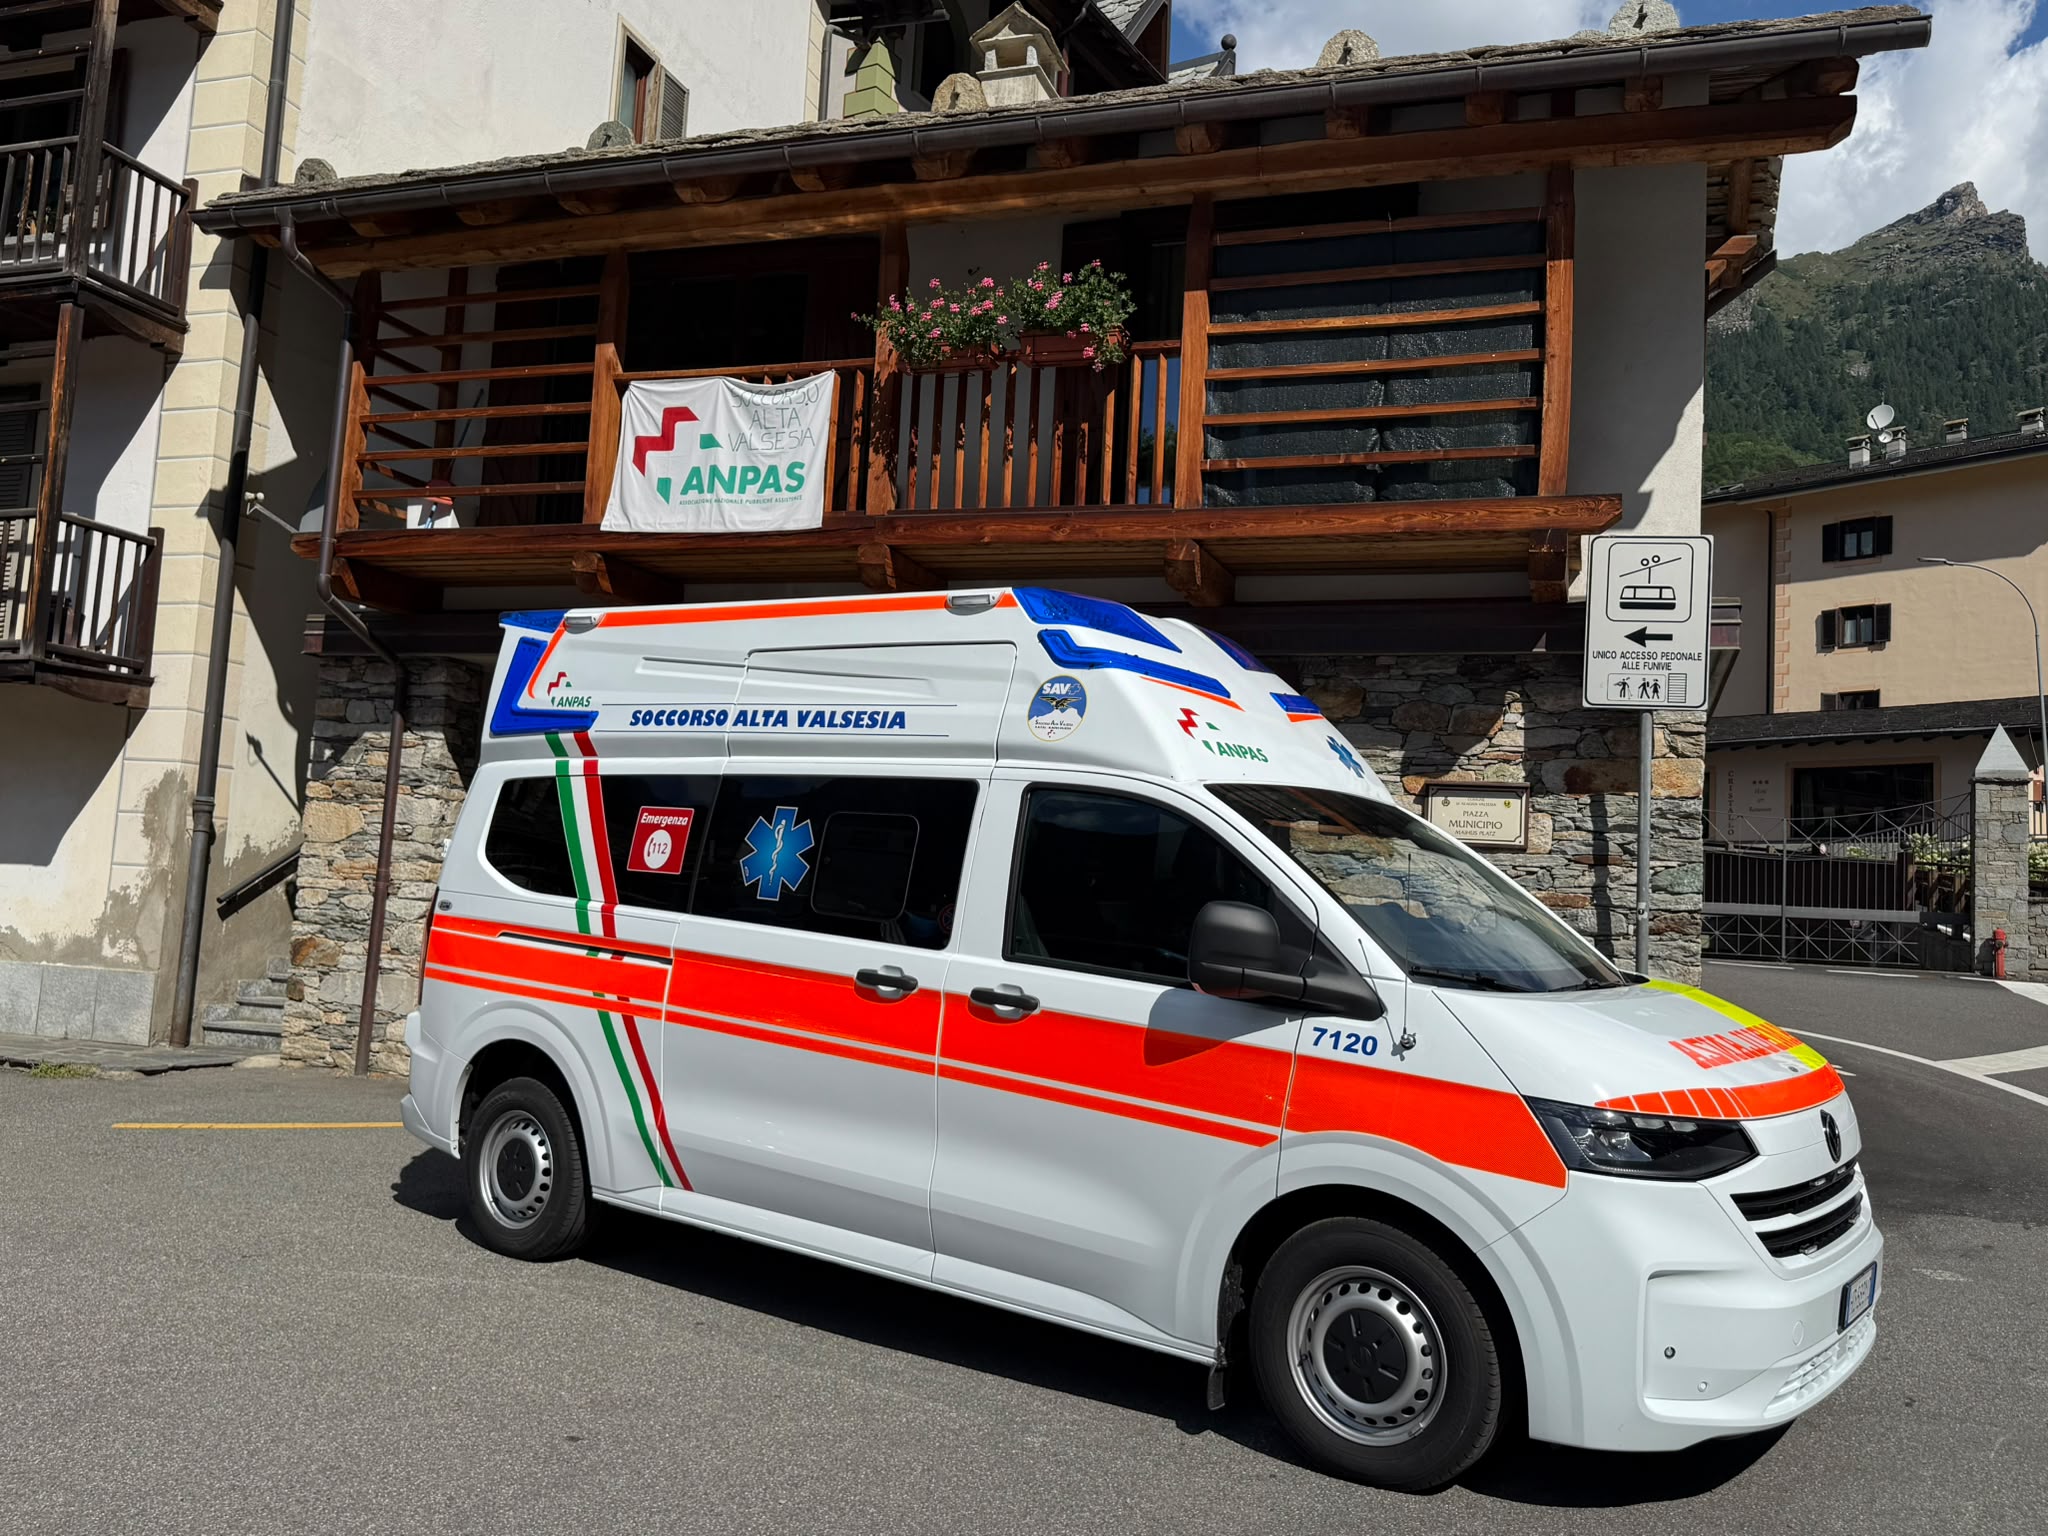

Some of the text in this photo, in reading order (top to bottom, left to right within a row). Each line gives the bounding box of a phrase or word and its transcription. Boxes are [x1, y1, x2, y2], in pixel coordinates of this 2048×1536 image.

[749, 407, 802, 431] ALTA
[728, 428, 816, 453] VALSESIA
[680, 461, 806, 496] ANPAS
[1592, 650, 1703, 661] UNICO ACCESSO PEDONALE
[1621, 661, 1672, 671] ALLE FUNIVIE
[1042, 683, 1071, 695] SAV
[556, 696, 592, 708] ANPAS
[629, 709, 906, 730] SOCCORSO ALTA VALSESIA
[1216, 741, 1269, 763] ANPAS
[641, 812, 688, 827] Emergenza
[1462, 810, 1489, 818] PIAZZA
[1448, 819, 1503, 830] MUNICIPIO
[652, 842, 668, 854] 112
[1313, 1026, 1378, 1056] 7120
